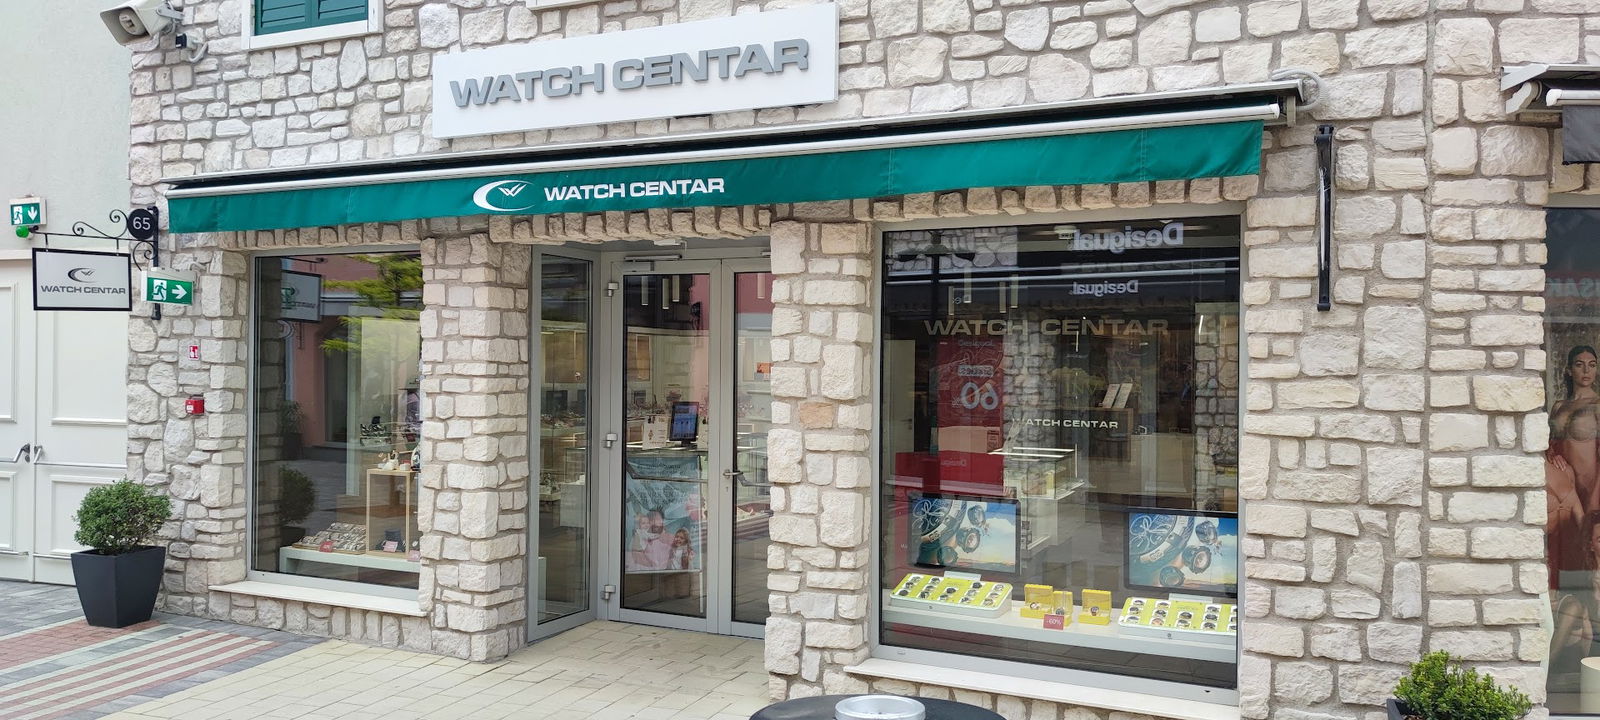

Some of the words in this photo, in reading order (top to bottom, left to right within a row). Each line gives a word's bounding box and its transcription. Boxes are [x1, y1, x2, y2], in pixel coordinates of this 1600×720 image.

[449, 63, 604, 108] WATCH
[612, 38, 810, 91] CENTAR
[544, 183, 625, 201] WATCH
[629, 178, 725, 197] CENTAR
[132, 216, 151, 231] 65
[40, 285, 82, 294] WATCH
[83, 286, 126, 295] CENTAR
[924, 319, 1028, 336] WATCH
[1041, 319, 1169, 336] CENTAR
[1063, 419, 1119, 429] CENTAR
